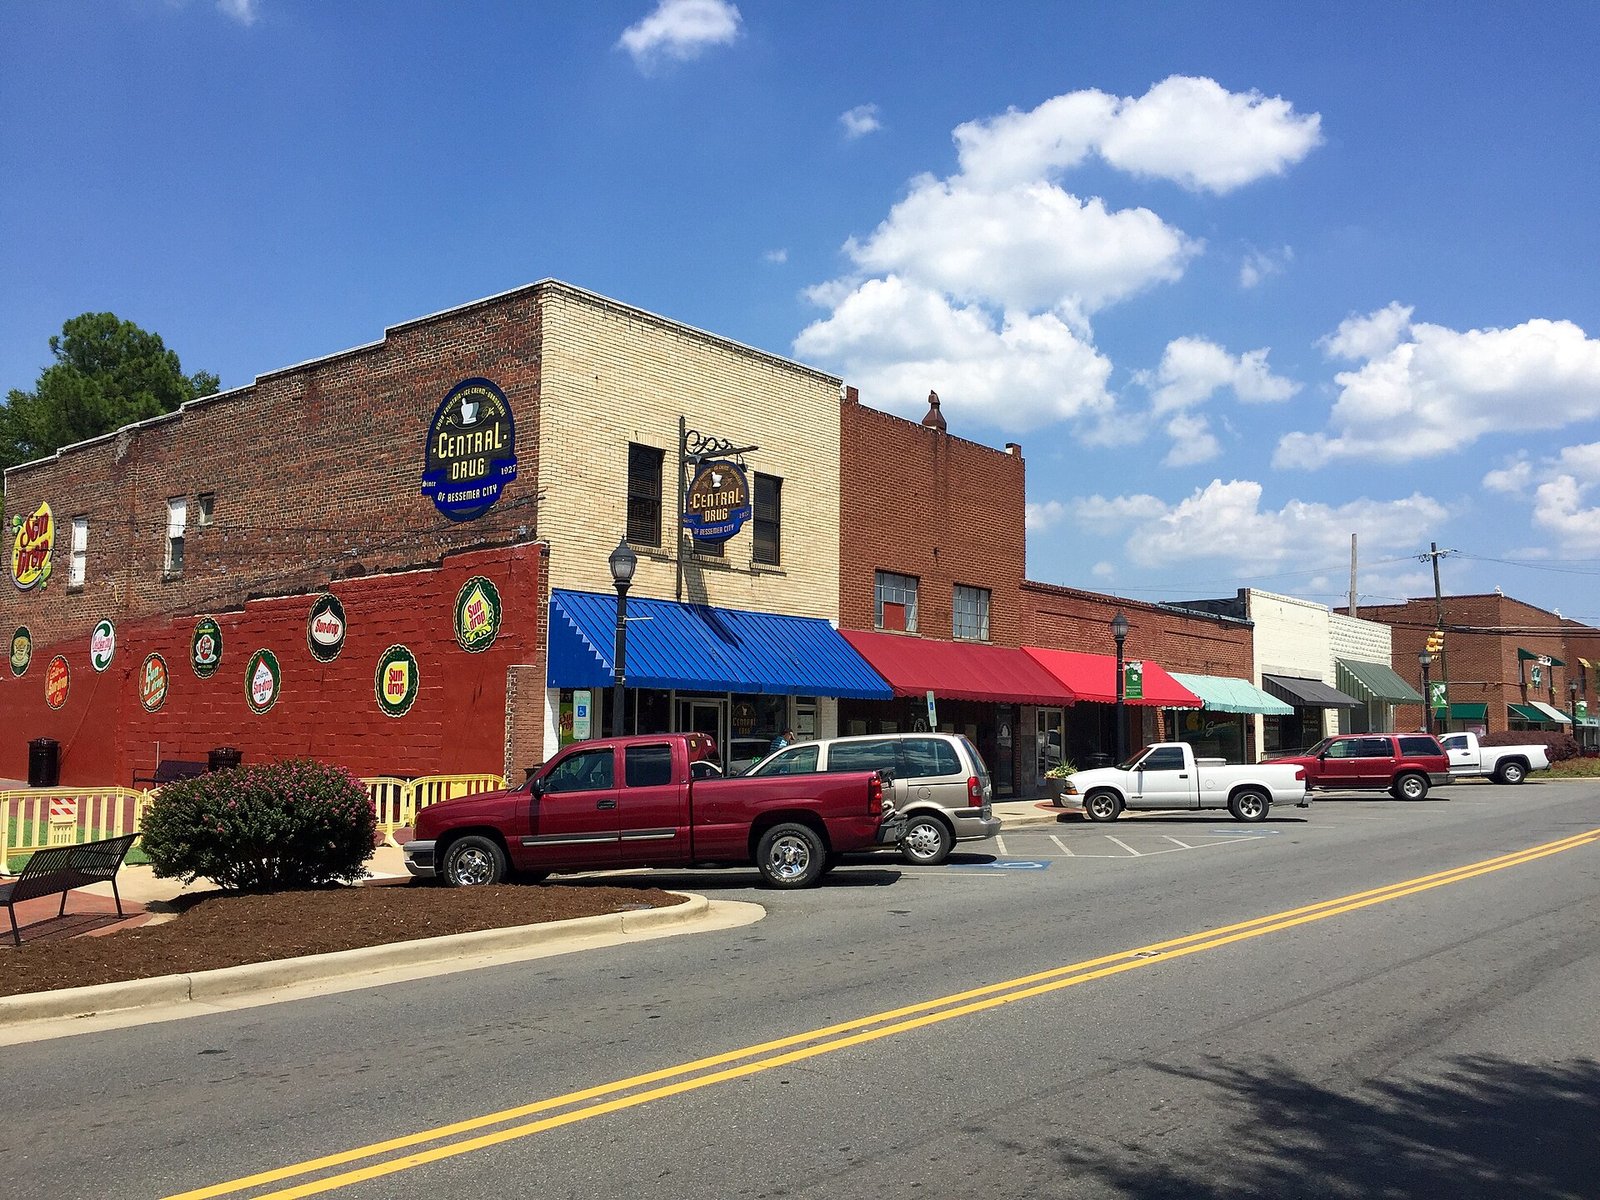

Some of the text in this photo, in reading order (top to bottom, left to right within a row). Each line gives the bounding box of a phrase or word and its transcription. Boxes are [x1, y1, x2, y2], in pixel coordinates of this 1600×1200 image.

[463, 387, 471, 396] ICE
[471, 387, 486, 395] CREAM
[438, 422, 502, 459] CENTRAL
[452, 457, 485, 480] DRUG
[501, 464, 516, 475] 1927
[438, 484, 498, 503] OF BESSEMER CITY
[693, 487, 741, 509] CENTRAL
[704, 508, 728, 522] DRUG
[20, 511, 49, 548] Sun
[723, 523, 735, 533] CITY
[16, 540, 49, 580] Drop
[315, 619, 340, 638] Sun-drop
[469, 611, 485, 631] drop
[253, 679, 273, 695] Sun-drop
[387, 682, 405, 696] drop
